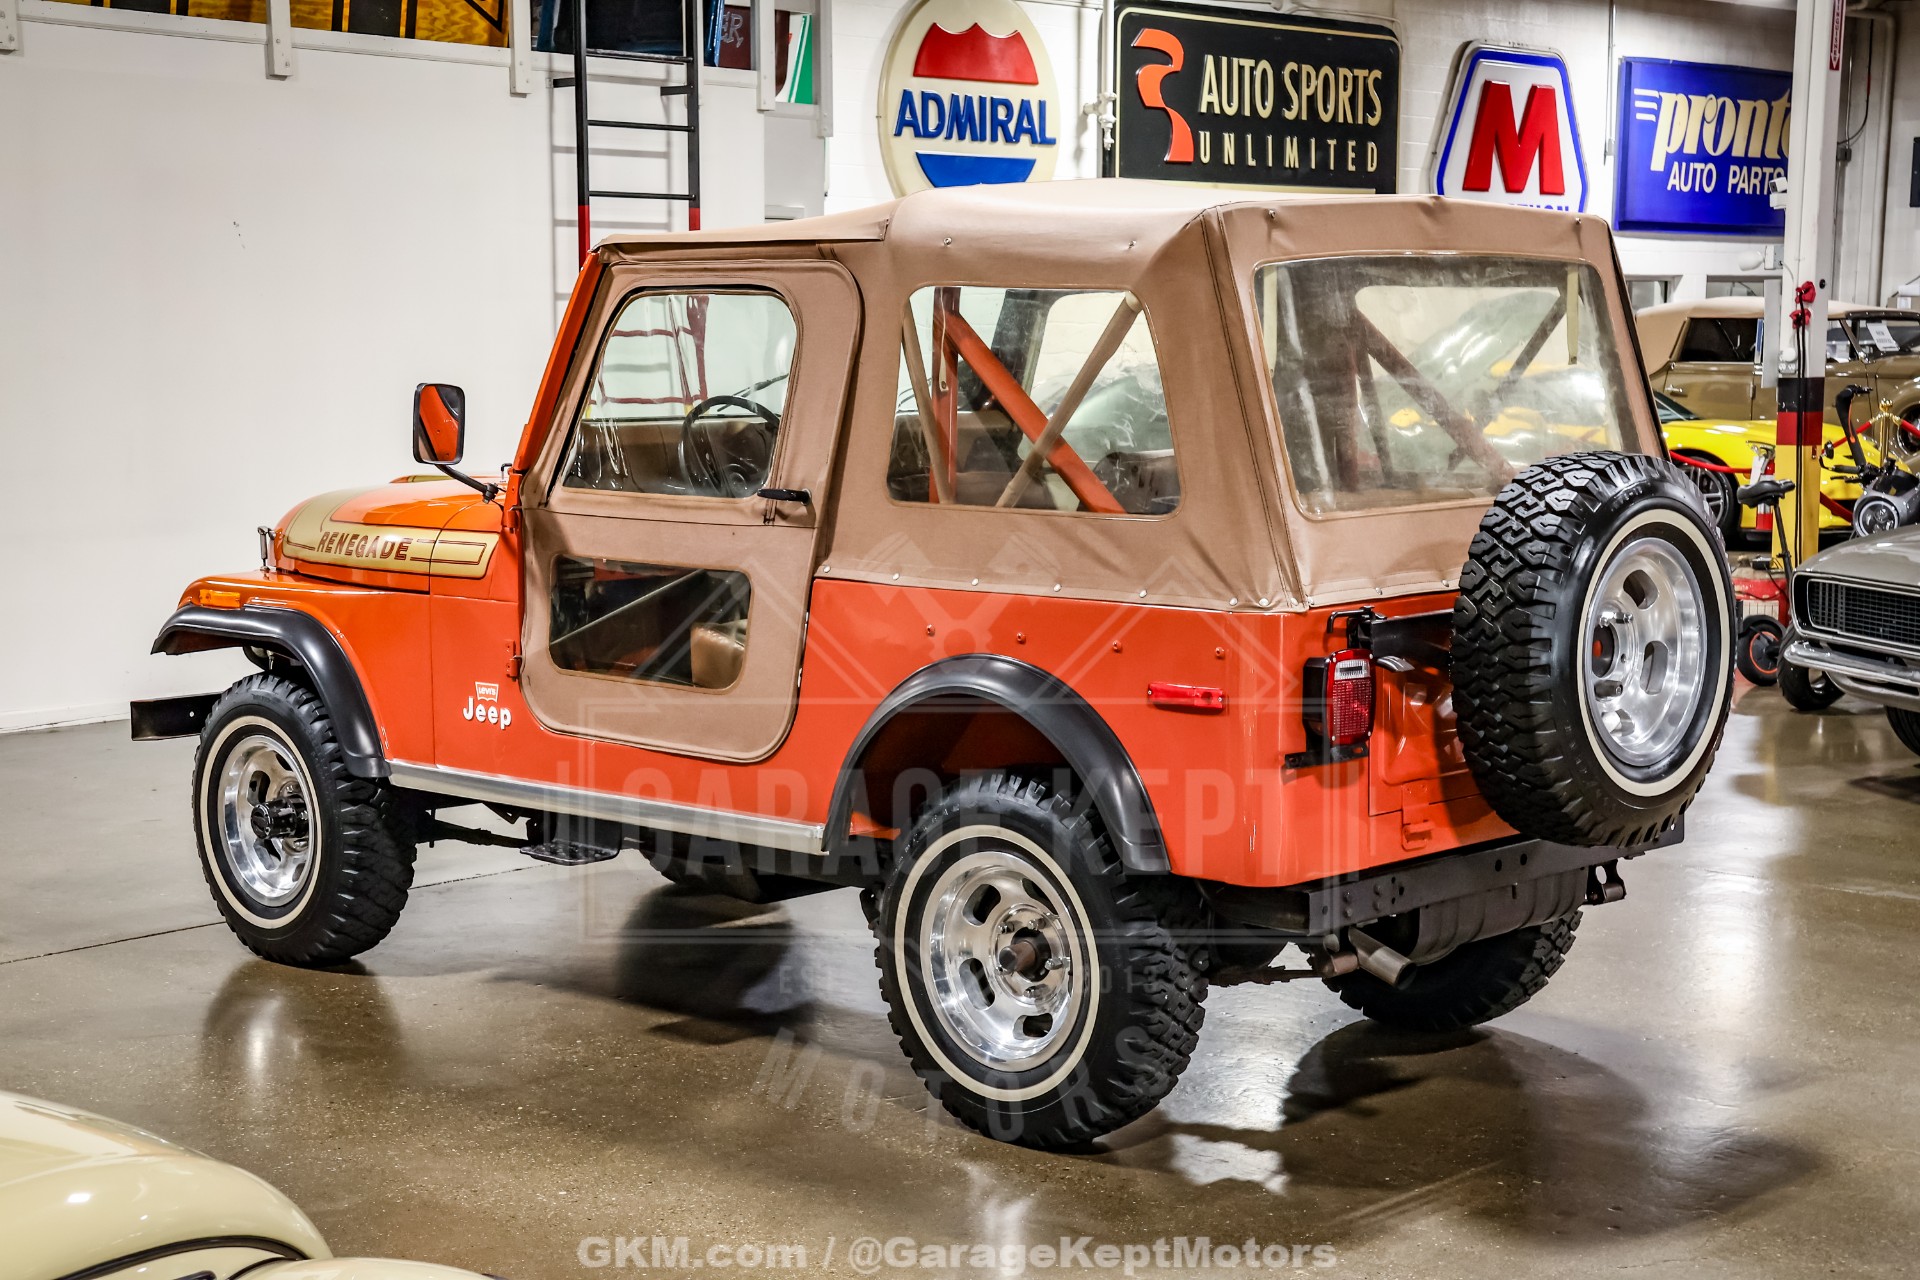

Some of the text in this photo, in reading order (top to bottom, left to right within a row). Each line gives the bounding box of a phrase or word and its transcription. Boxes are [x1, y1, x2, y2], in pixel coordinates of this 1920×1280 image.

[1199, 54, 1383, 127] AUTO SPORTS
[893, 88, 1056, 145] ADMIRAL
[1462, 79, 1566, 195] M
[1199, 130, 1378, 173] UNLIMITED
[1666, 160, 1717, 194] AUTO
[316, 531, 413, 561] RENEGADE
[462, 695, 512, 731] Jeep
